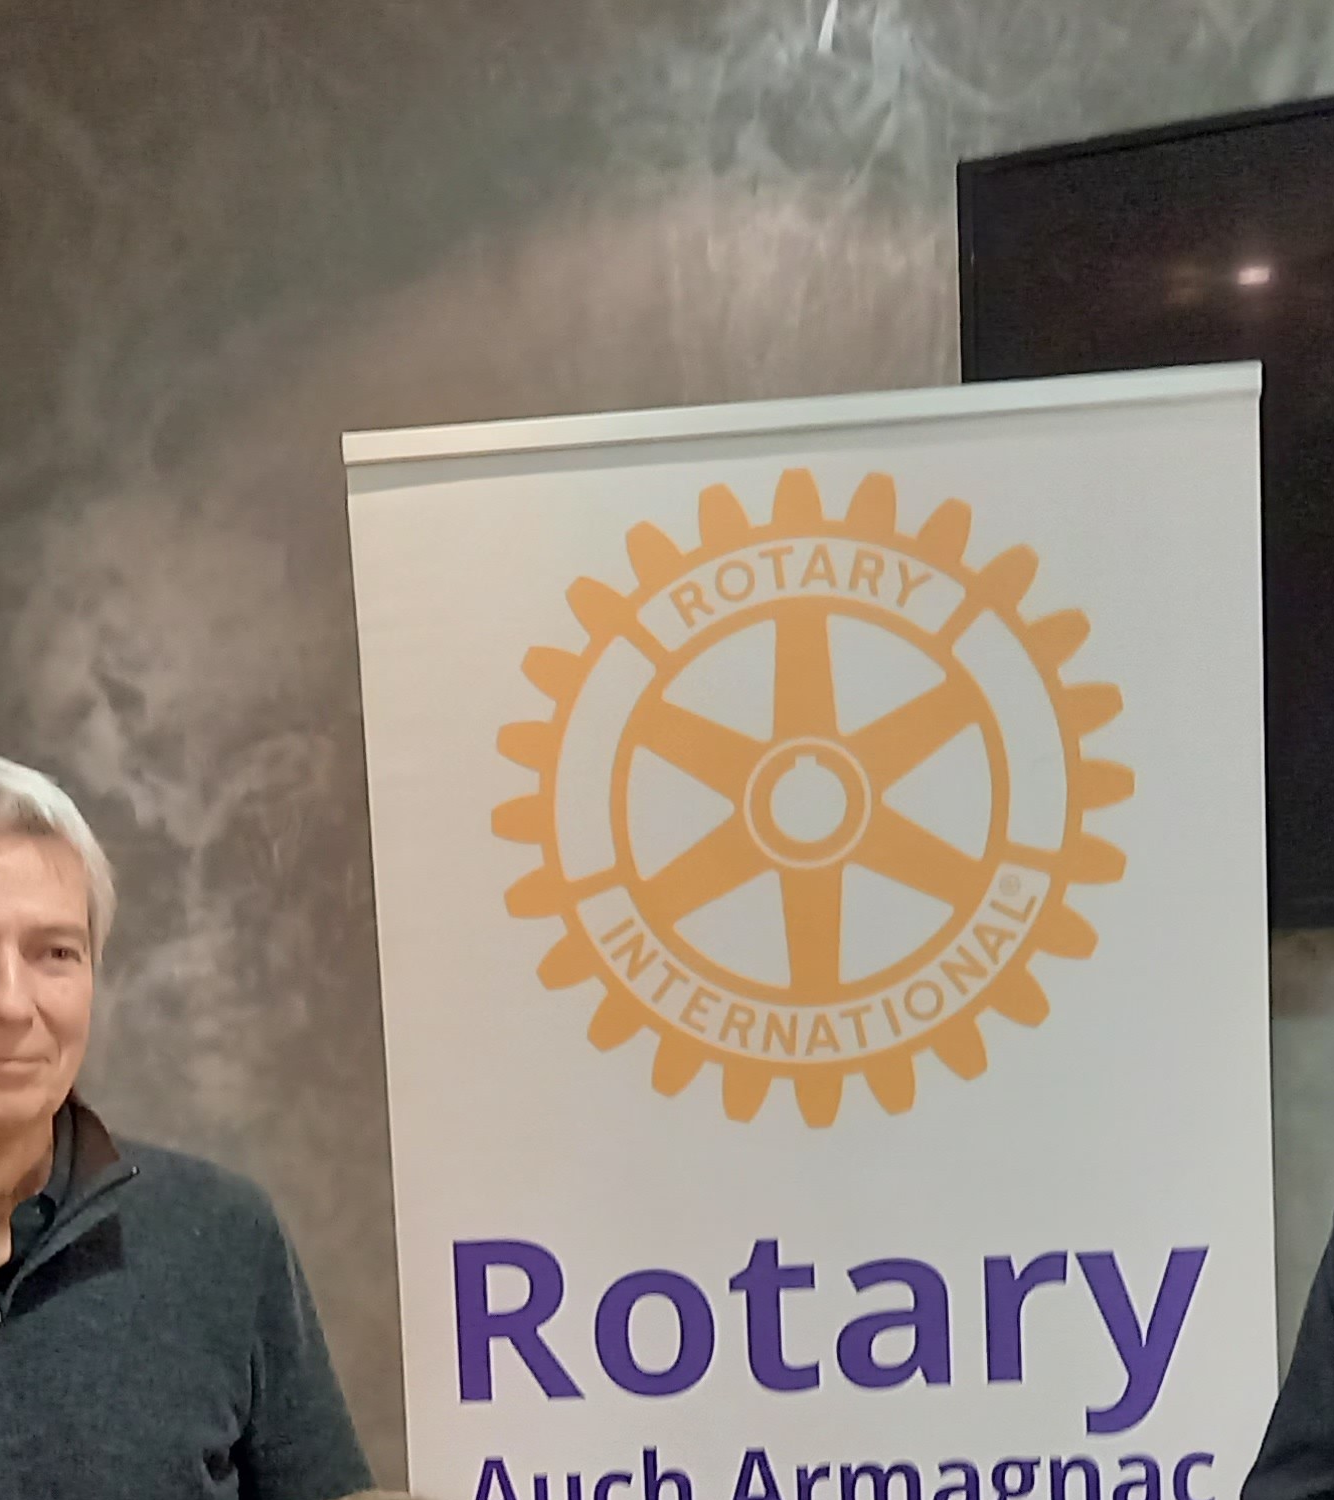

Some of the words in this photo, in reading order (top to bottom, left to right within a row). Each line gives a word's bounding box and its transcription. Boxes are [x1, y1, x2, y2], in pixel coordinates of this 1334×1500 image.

[669, 544, 933, 631] ROTARY
[599, 893, 1038, 1058] INTERNATIONAL
[452, 1238, 1210, 1435] Rotary
